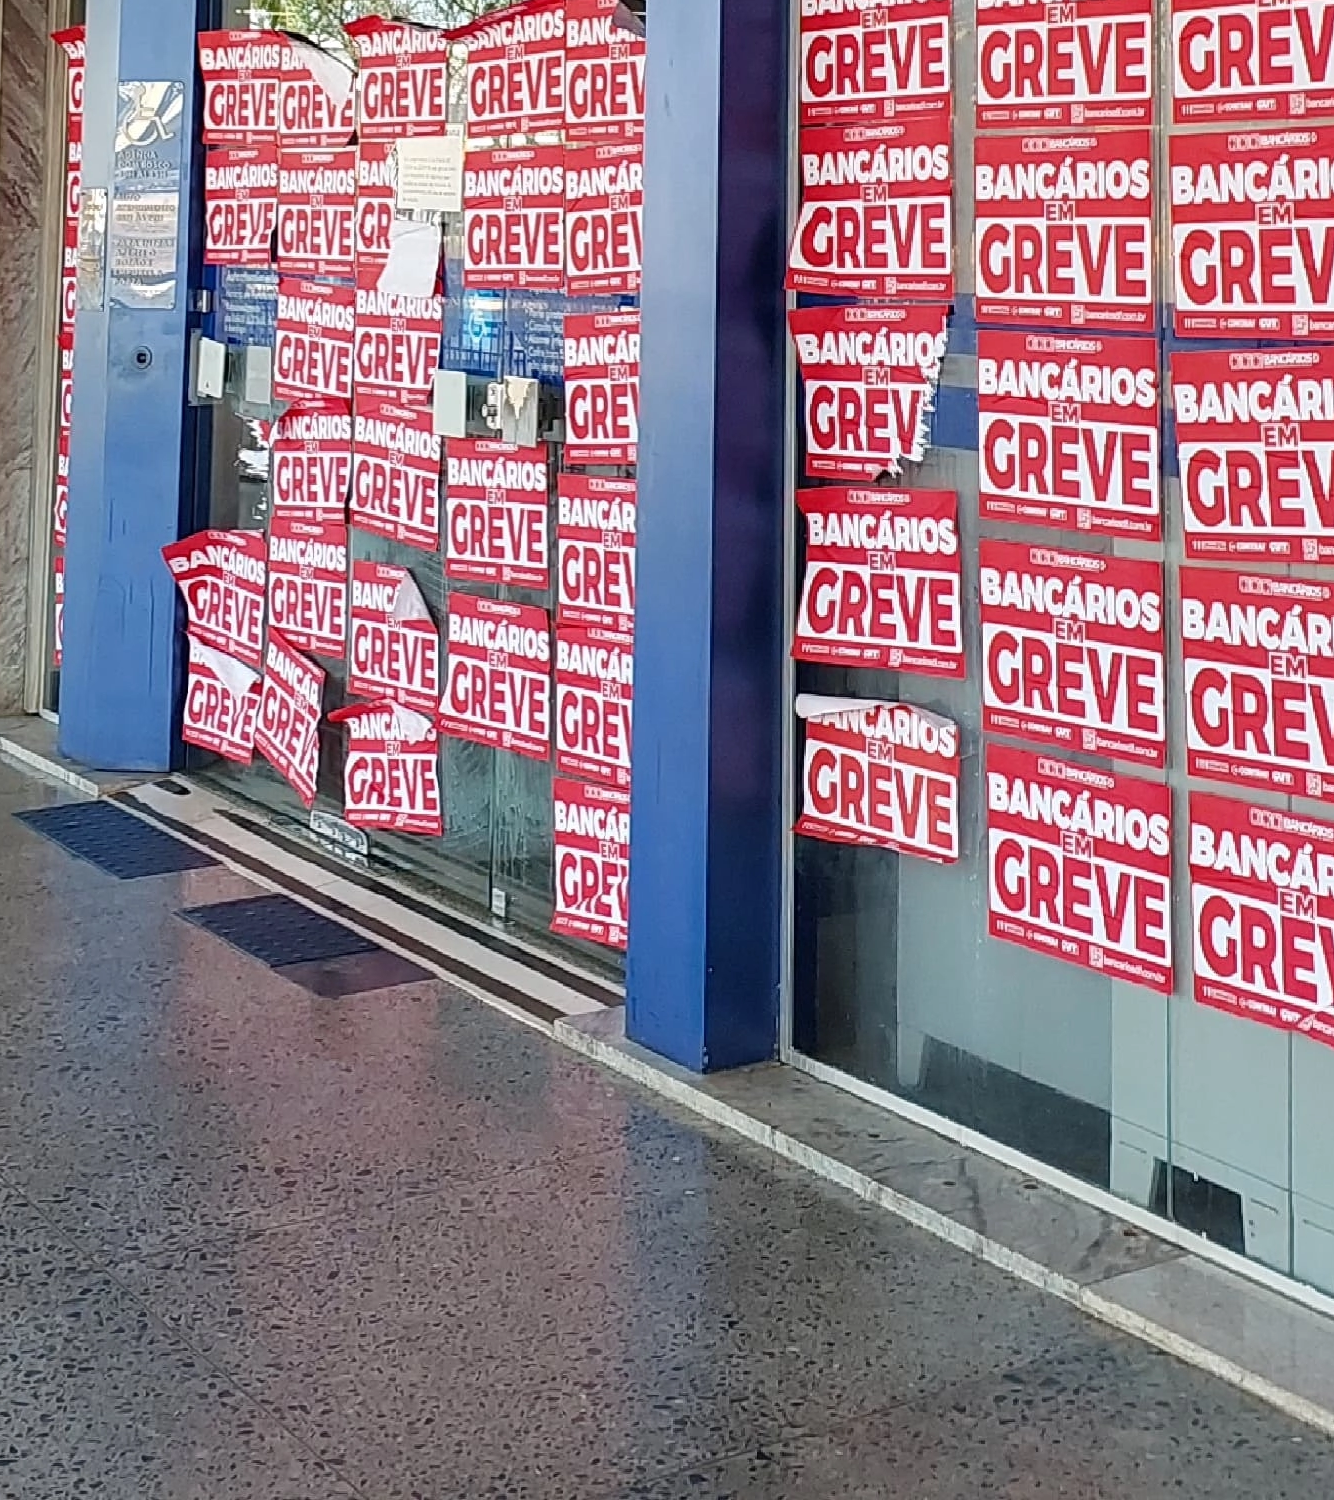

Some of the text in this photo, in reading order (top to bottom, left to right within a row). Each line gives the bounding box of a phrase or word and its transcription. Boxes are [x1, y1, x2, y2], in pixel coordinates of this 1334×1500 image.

[467, 10, 563, 50] BANCÁRIOS
[862, 10, 887, 27] EM
[1047, 5, 1075, 23] EM
[203, 44, 279, 70] BANCÁRIOS
[806, 23, 944, 97] GREVE
[981, 21, 1147, 99] GREVE
[209, 83, 275, 126] GREVE
[365, 69, 442, 118] GREVE
[471, 57, 562, 116] GREVE
[569, 60, 645, 118] GREV
[207, 163, 277, 190] BANCÁRIOS
[280, 167, 354, 193] BANCÁRIOS
[464, 164, 564, 197] BANCÁRIOS
[566, 160, 643, 199] BANCÁR
[803, 145, 949, 187] BANCÁRIOS
[975, 157, 1150, 201] BANCÁRIOS
[863, 186, 887, 202] EM
[1046, 202, 1074, 221] EM
[1258, 205, 1293, 225] EM
[209, 202, 273, 246] GREVE
[282, 209, 352, 255] GREVE
[468, 212, 559, 265] GREVE
[800, 203, 945, 269] GREVE
[980, 223, 1147, 298] GREVE
[278, 295, 354, 331] BANCÁRIOS
[278, 334, 350, 394] GREVE
[357, 330, 438, 385] GREVE
[566, 330, 640, 367] BANCÁR
[865, 368, 889, 386] EM
[979, 359, 1156, 408] BANCÁRIOS
[810, 385, 919, 454] GREV
[1051, 402, 1080, 422] EM
[355, 416, 440, 460] BANCÁRIOS
[1264, 425, 1299, 446] EM
[277, 456, 348, 502] GREVE
[448, 456, 547, 491] BANCÁRIOS
[985, 419, 1151, 508] GREVE
[353, 459, 435, 527] GREVE
[559, 497, 636, 532] BANCÁR
[270, 536, 346, 572] BANCÁRIOS
[451, 503, 543, 562] GREVE
[807, 511, 956, 555] BANCÁRIOS
[168, 545, 265, 585] BANCÁRIOS
[870, 552, 895, 571] EM
[188, 580, 260, 648] GREVE
[272, 577, 342, 637] GREVE
[808, 567, 956, 647] GREVE
[980, 567, 1160, 632] BANCÁRIOS
[449, 614, 549, 661] BANCÁRIOS
[1056, 619, 1084, 642] EM
[354, 624, 434, 690] GREVE
[557, 640, 632, 684] BANCÁR
[1271, 653, 1307, 678] EM
[451, 661, 545, 734] GREVE
[988, 630, 1156, 732] GREVE
[868, 740, 894, 762] EM
[349, 757, 436, 811] GREVE
[809, 748, 953, 849] GREVE
[555, 800, 629, 842] BANCÁR
[987, 773, 1169, 856] BANCÁRIOS
[1063, 834, 1092, 858] EM
[996, 839, 1164, 957] GREVE
[1281, 891, 1316, 919] EM
